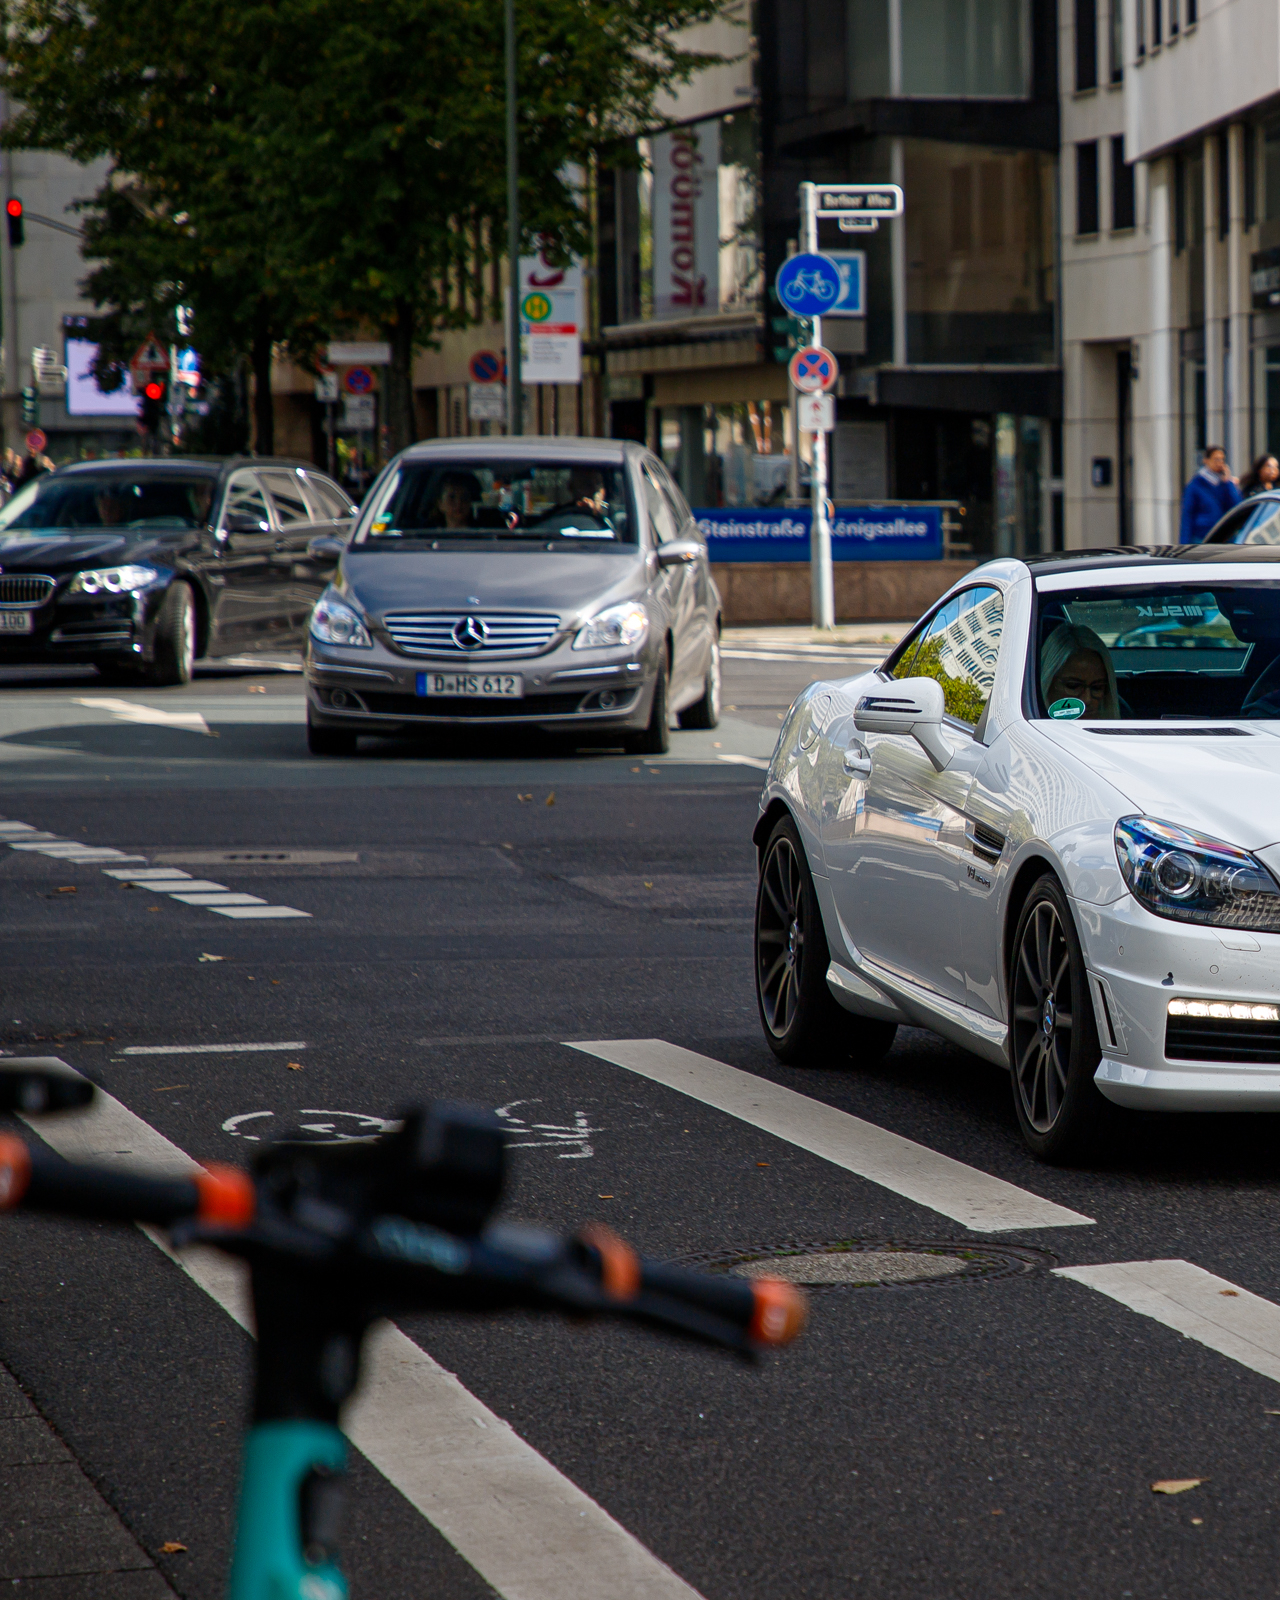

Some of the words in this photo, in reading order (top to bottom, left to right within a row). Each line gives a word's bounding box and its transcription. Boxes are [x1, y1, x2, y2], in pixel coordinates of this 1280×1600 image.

[699, 518, 805, 538] Steinstraße
[456, 675, 478, 693] HS
[483, 675, 515, 693] 612
[1061, 700, 1071, 709] 4
